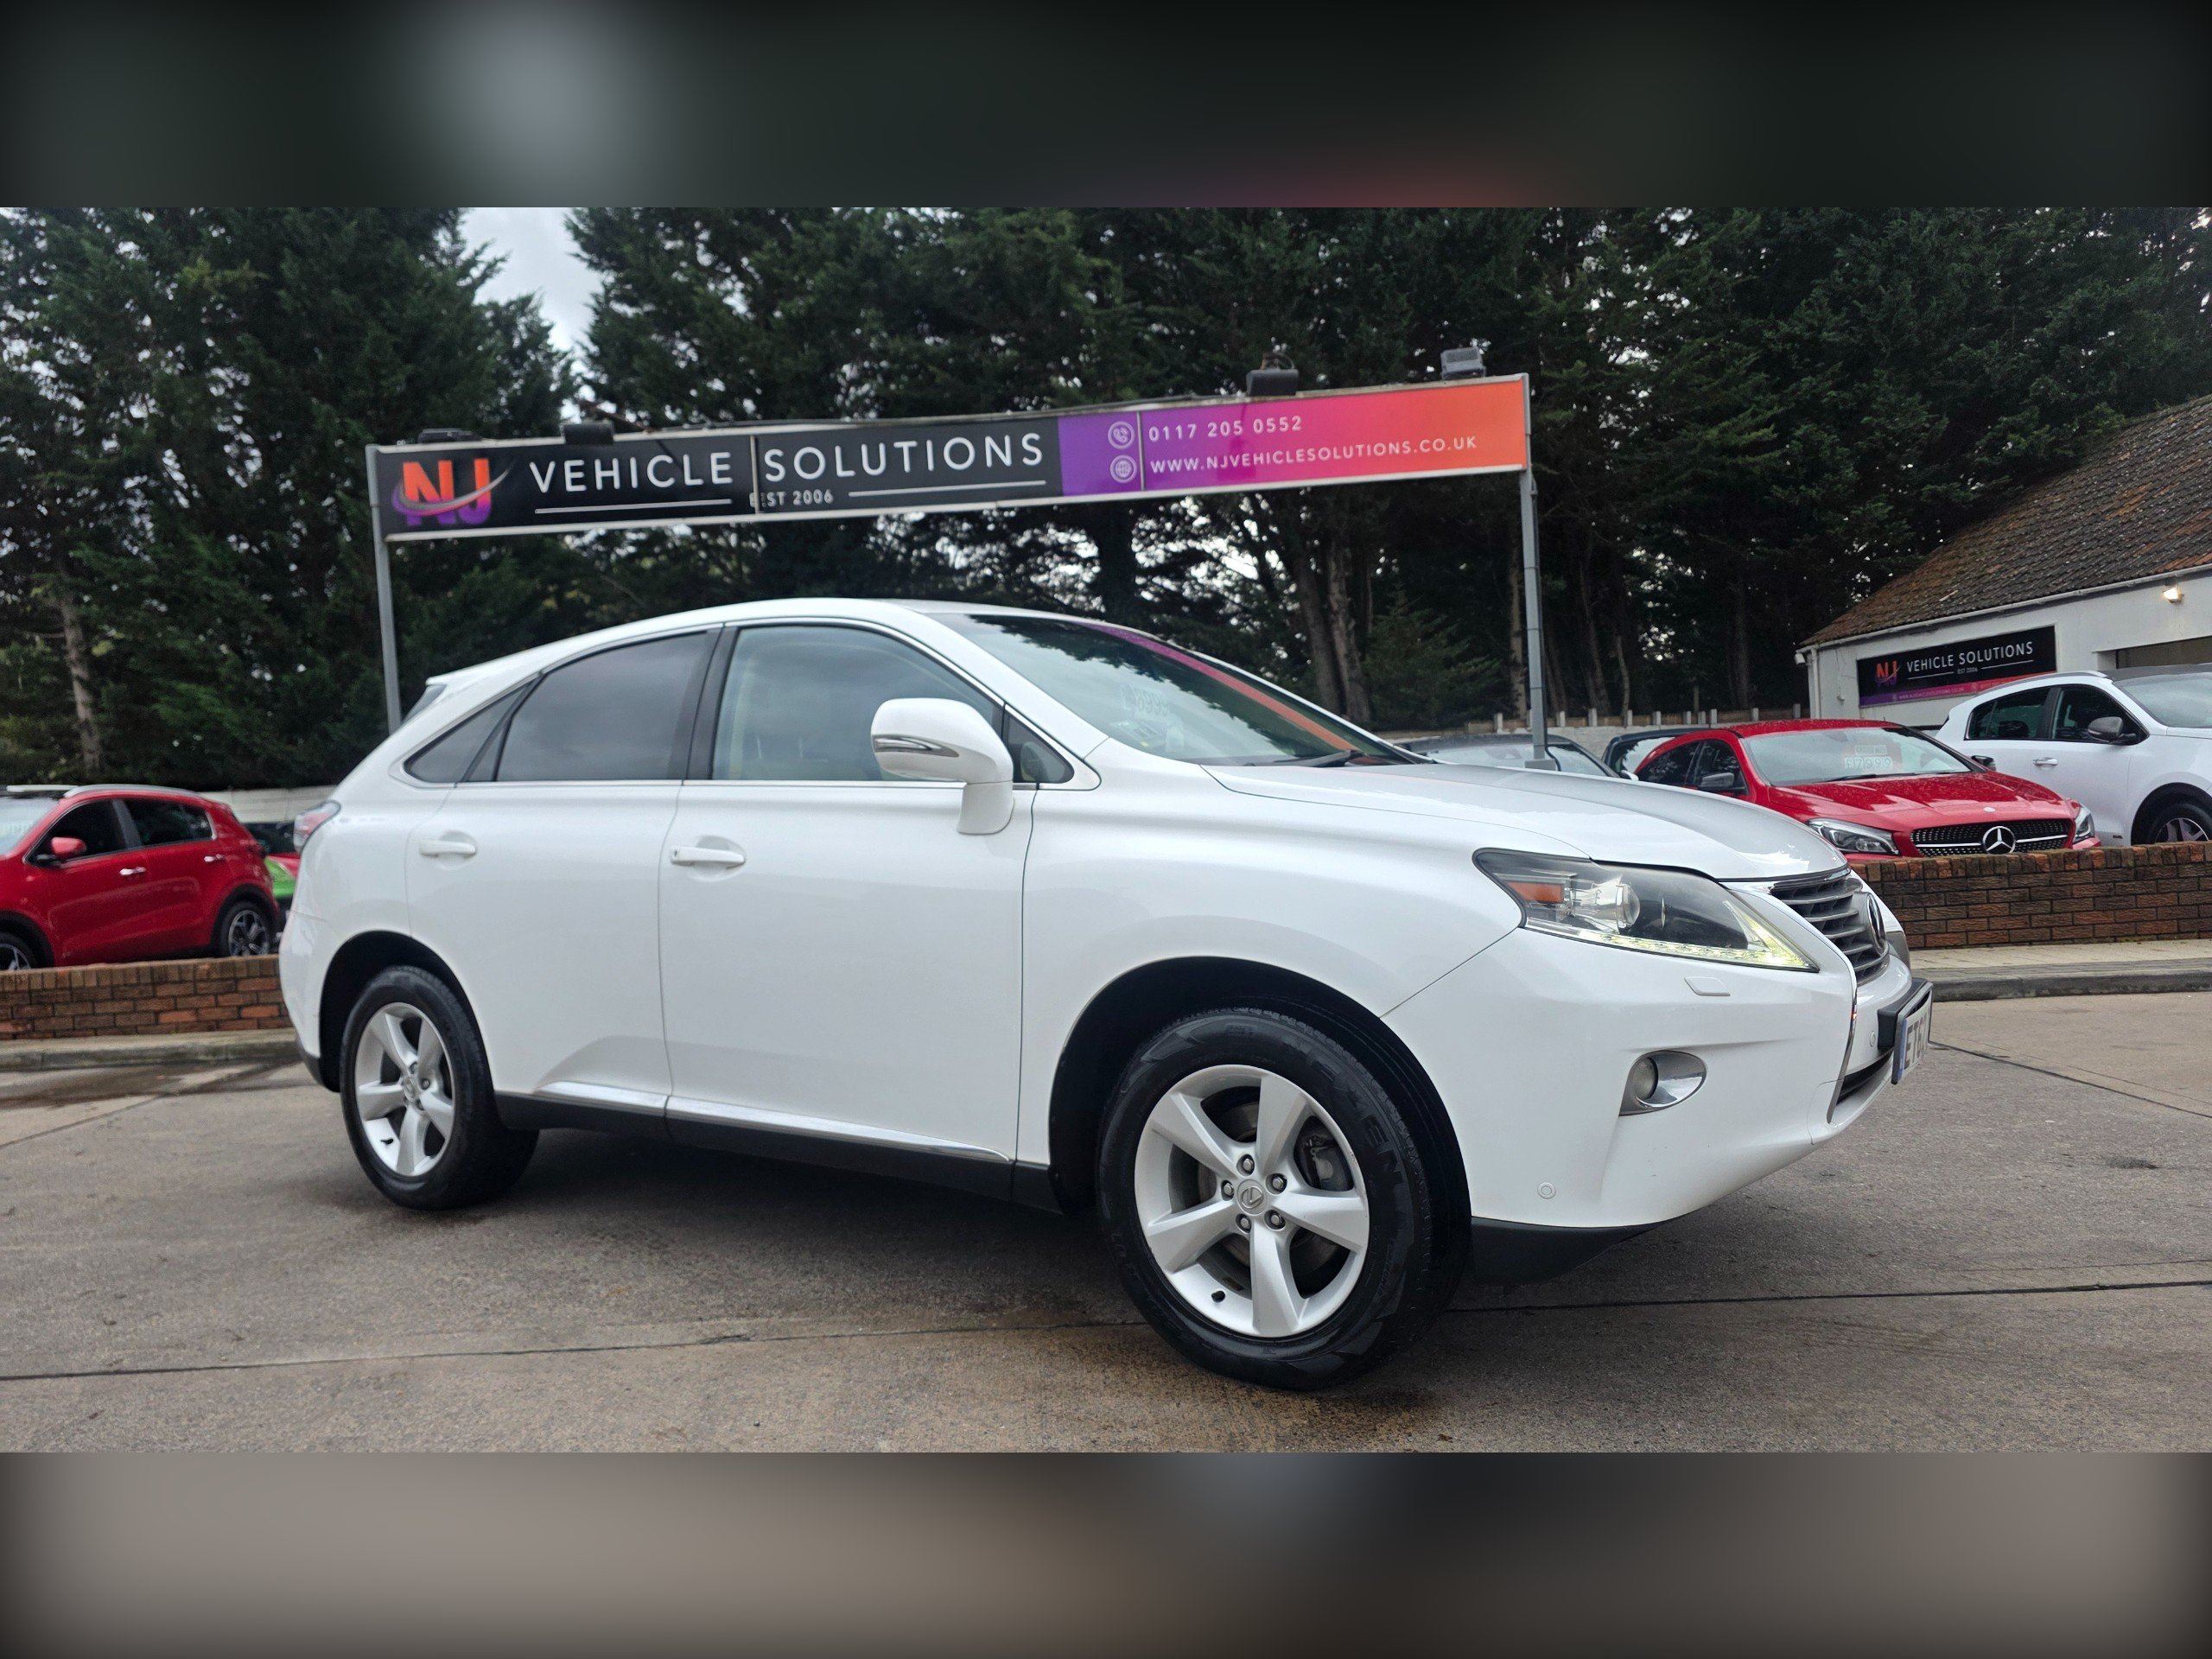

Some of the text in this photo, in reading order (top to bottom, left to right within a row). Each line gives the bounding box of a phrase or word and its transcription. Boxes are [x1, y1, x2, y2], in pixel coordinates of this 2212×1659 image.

[1148, 416, 1303, 442] 0117 205 0552
[1150, 435, 1477, 474] WWW.NJVEHICLESOLUTIONS.CO.UK
[402, 432, 1043, 527] NJ VEHICLE SOLUTIONS
[792, 488, 834, 505] 2006
[1906, 653, 1955, 673] VEHICLE
[1958, 640, 2034, 666] SOLUTIONS
